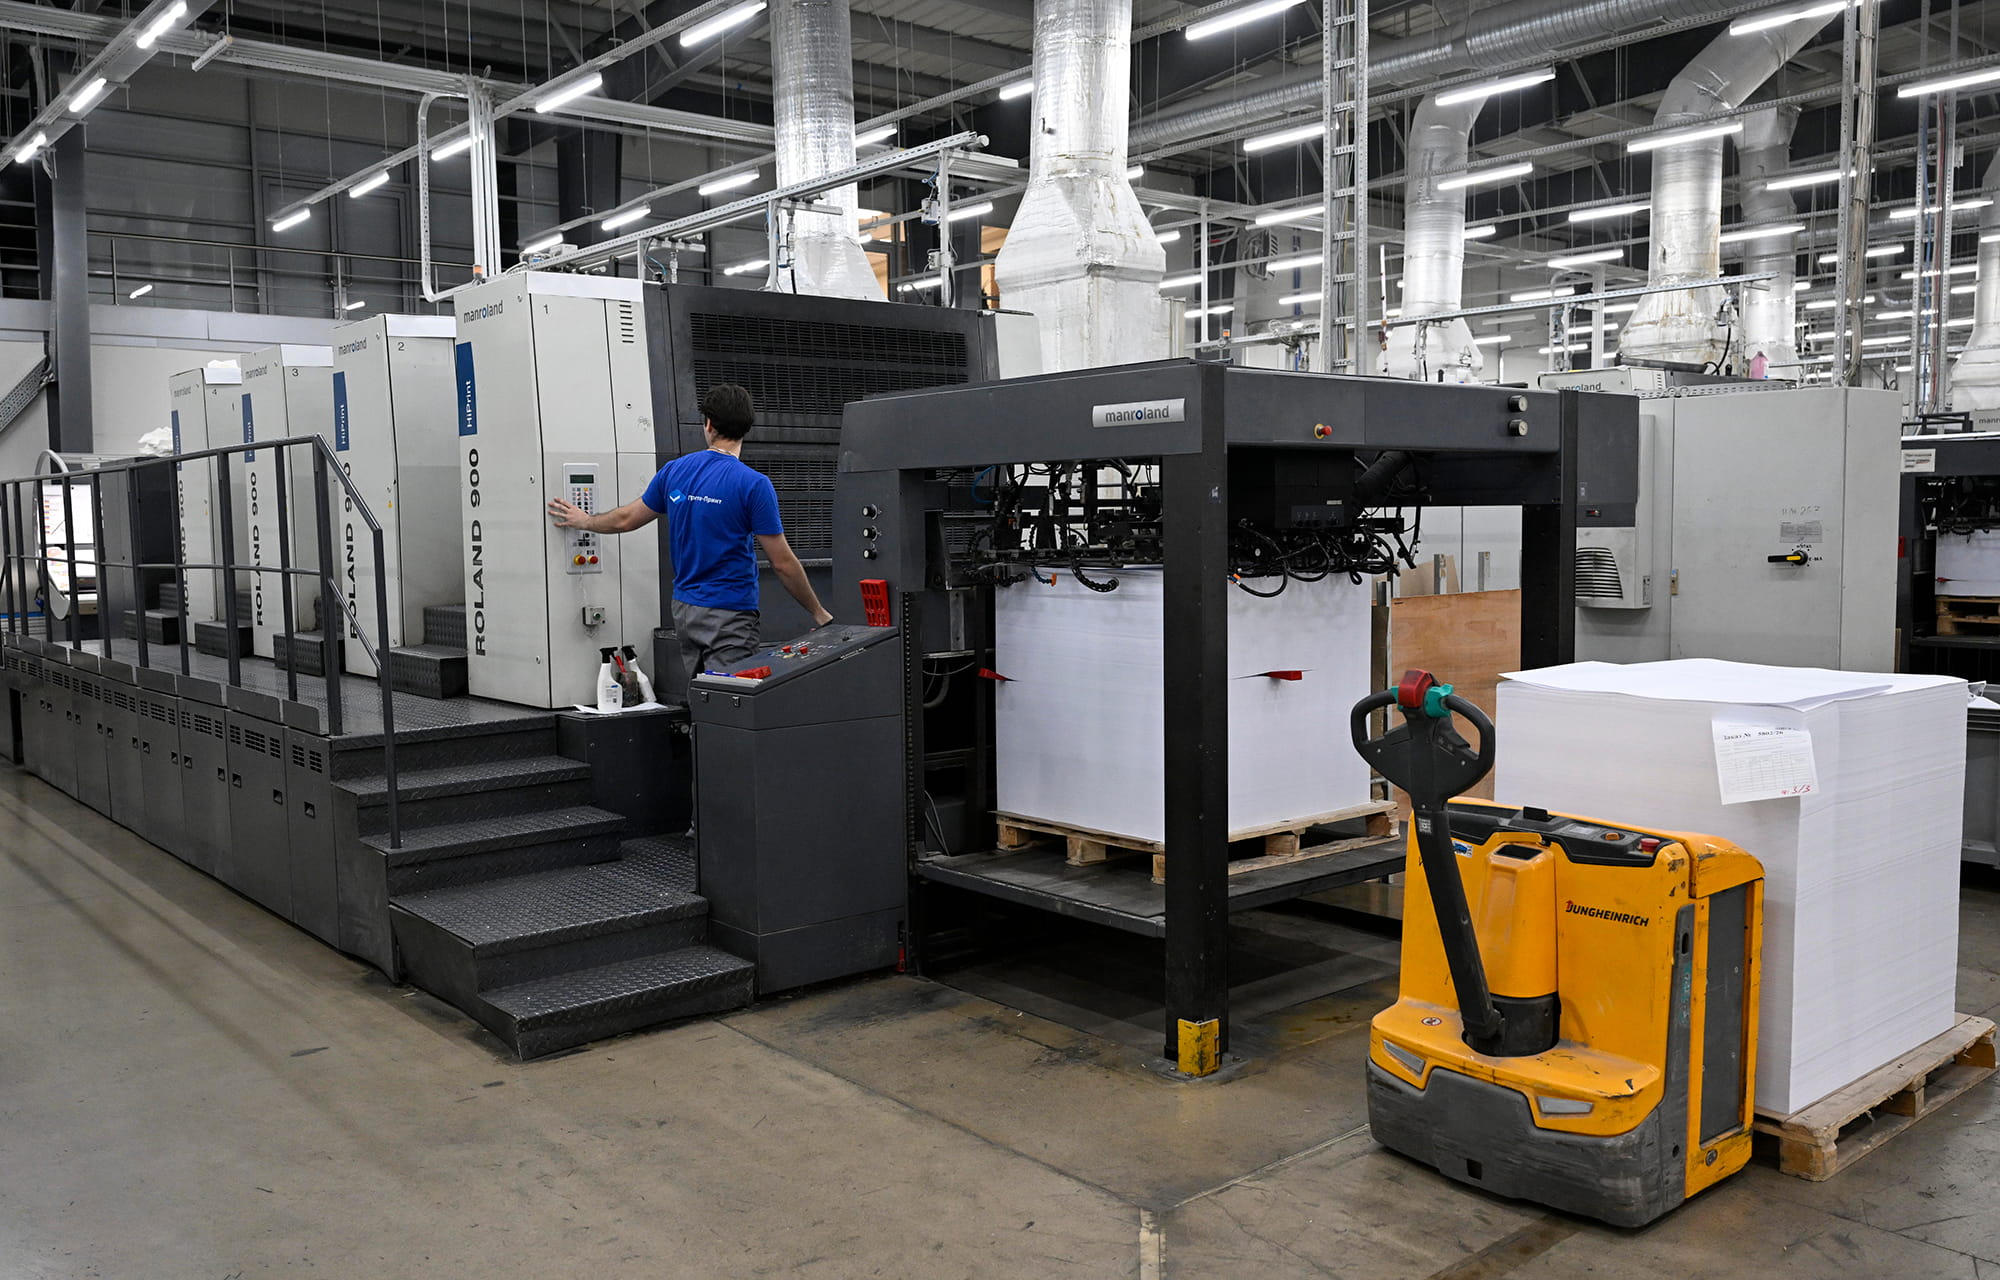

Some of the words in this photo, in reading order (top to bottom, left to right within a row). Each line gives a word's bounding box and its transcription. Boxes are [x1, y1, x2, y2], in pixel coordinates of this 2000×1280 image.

[463, 301, 504, 323] manroland
[543, 304, 549, 314] 1
[338, 337, 367, 355] manroland
[398, 342, 405, 351] 2
[292, 368, 299, 377] 3
[465, 380, 473, 428] HiPrint
[1105, 405, 1170, 423] manroland
[344, 462, 352, 512] 90
[469, 448, 481, 508] 900
[250, 472, 258, 516] 900
[253, 525, 263, 626] ROLAND
[471, 519, 486, 656] ROLAND
[1566, 903, 1649, 926] JUNGHEINRICH
